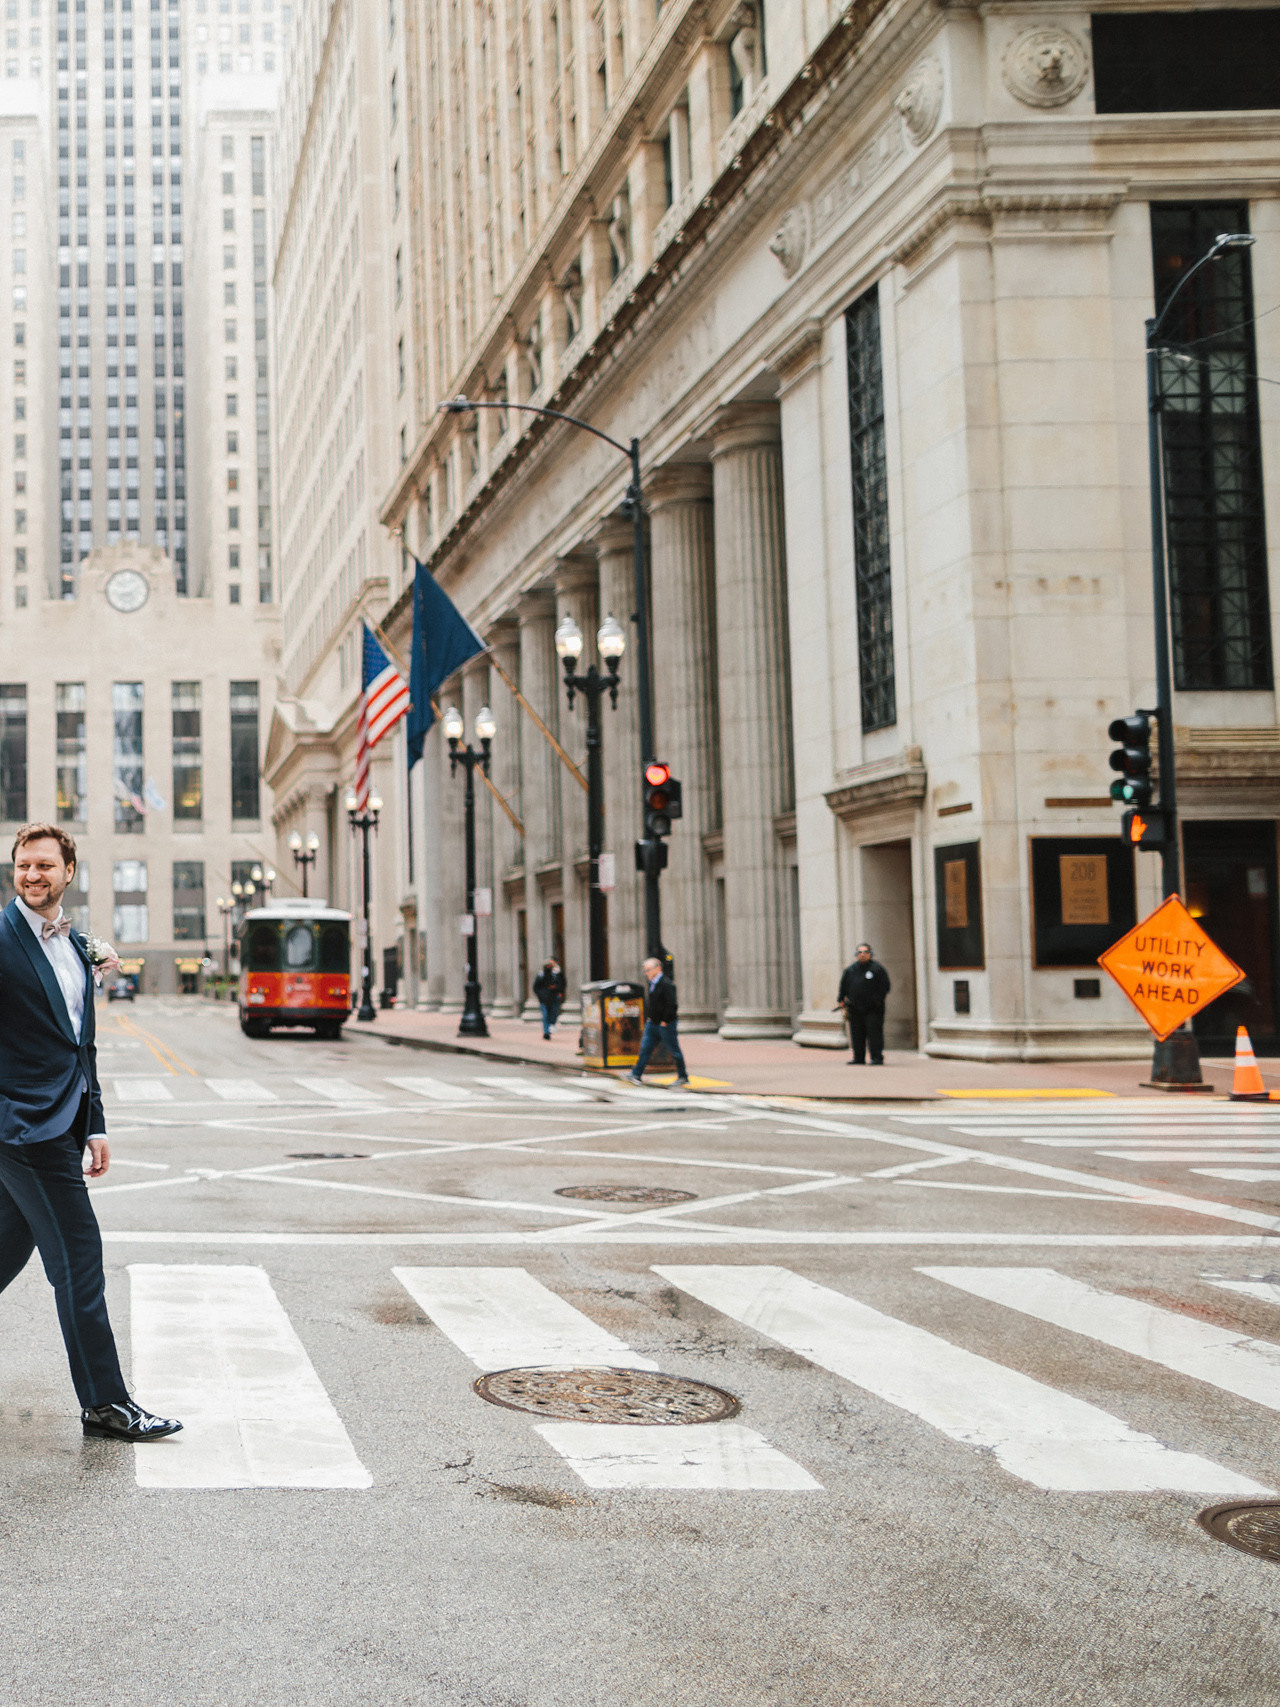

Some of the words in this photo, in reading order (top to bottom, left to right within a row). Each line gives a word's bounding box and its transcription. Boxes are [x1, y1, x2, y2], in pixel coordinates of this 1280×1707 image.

[1134, 936, 1206, 957] UTILITY
[1141, 959, 1194, 980] WORK
[1133, 983, 1199, 1005] AHEAD
